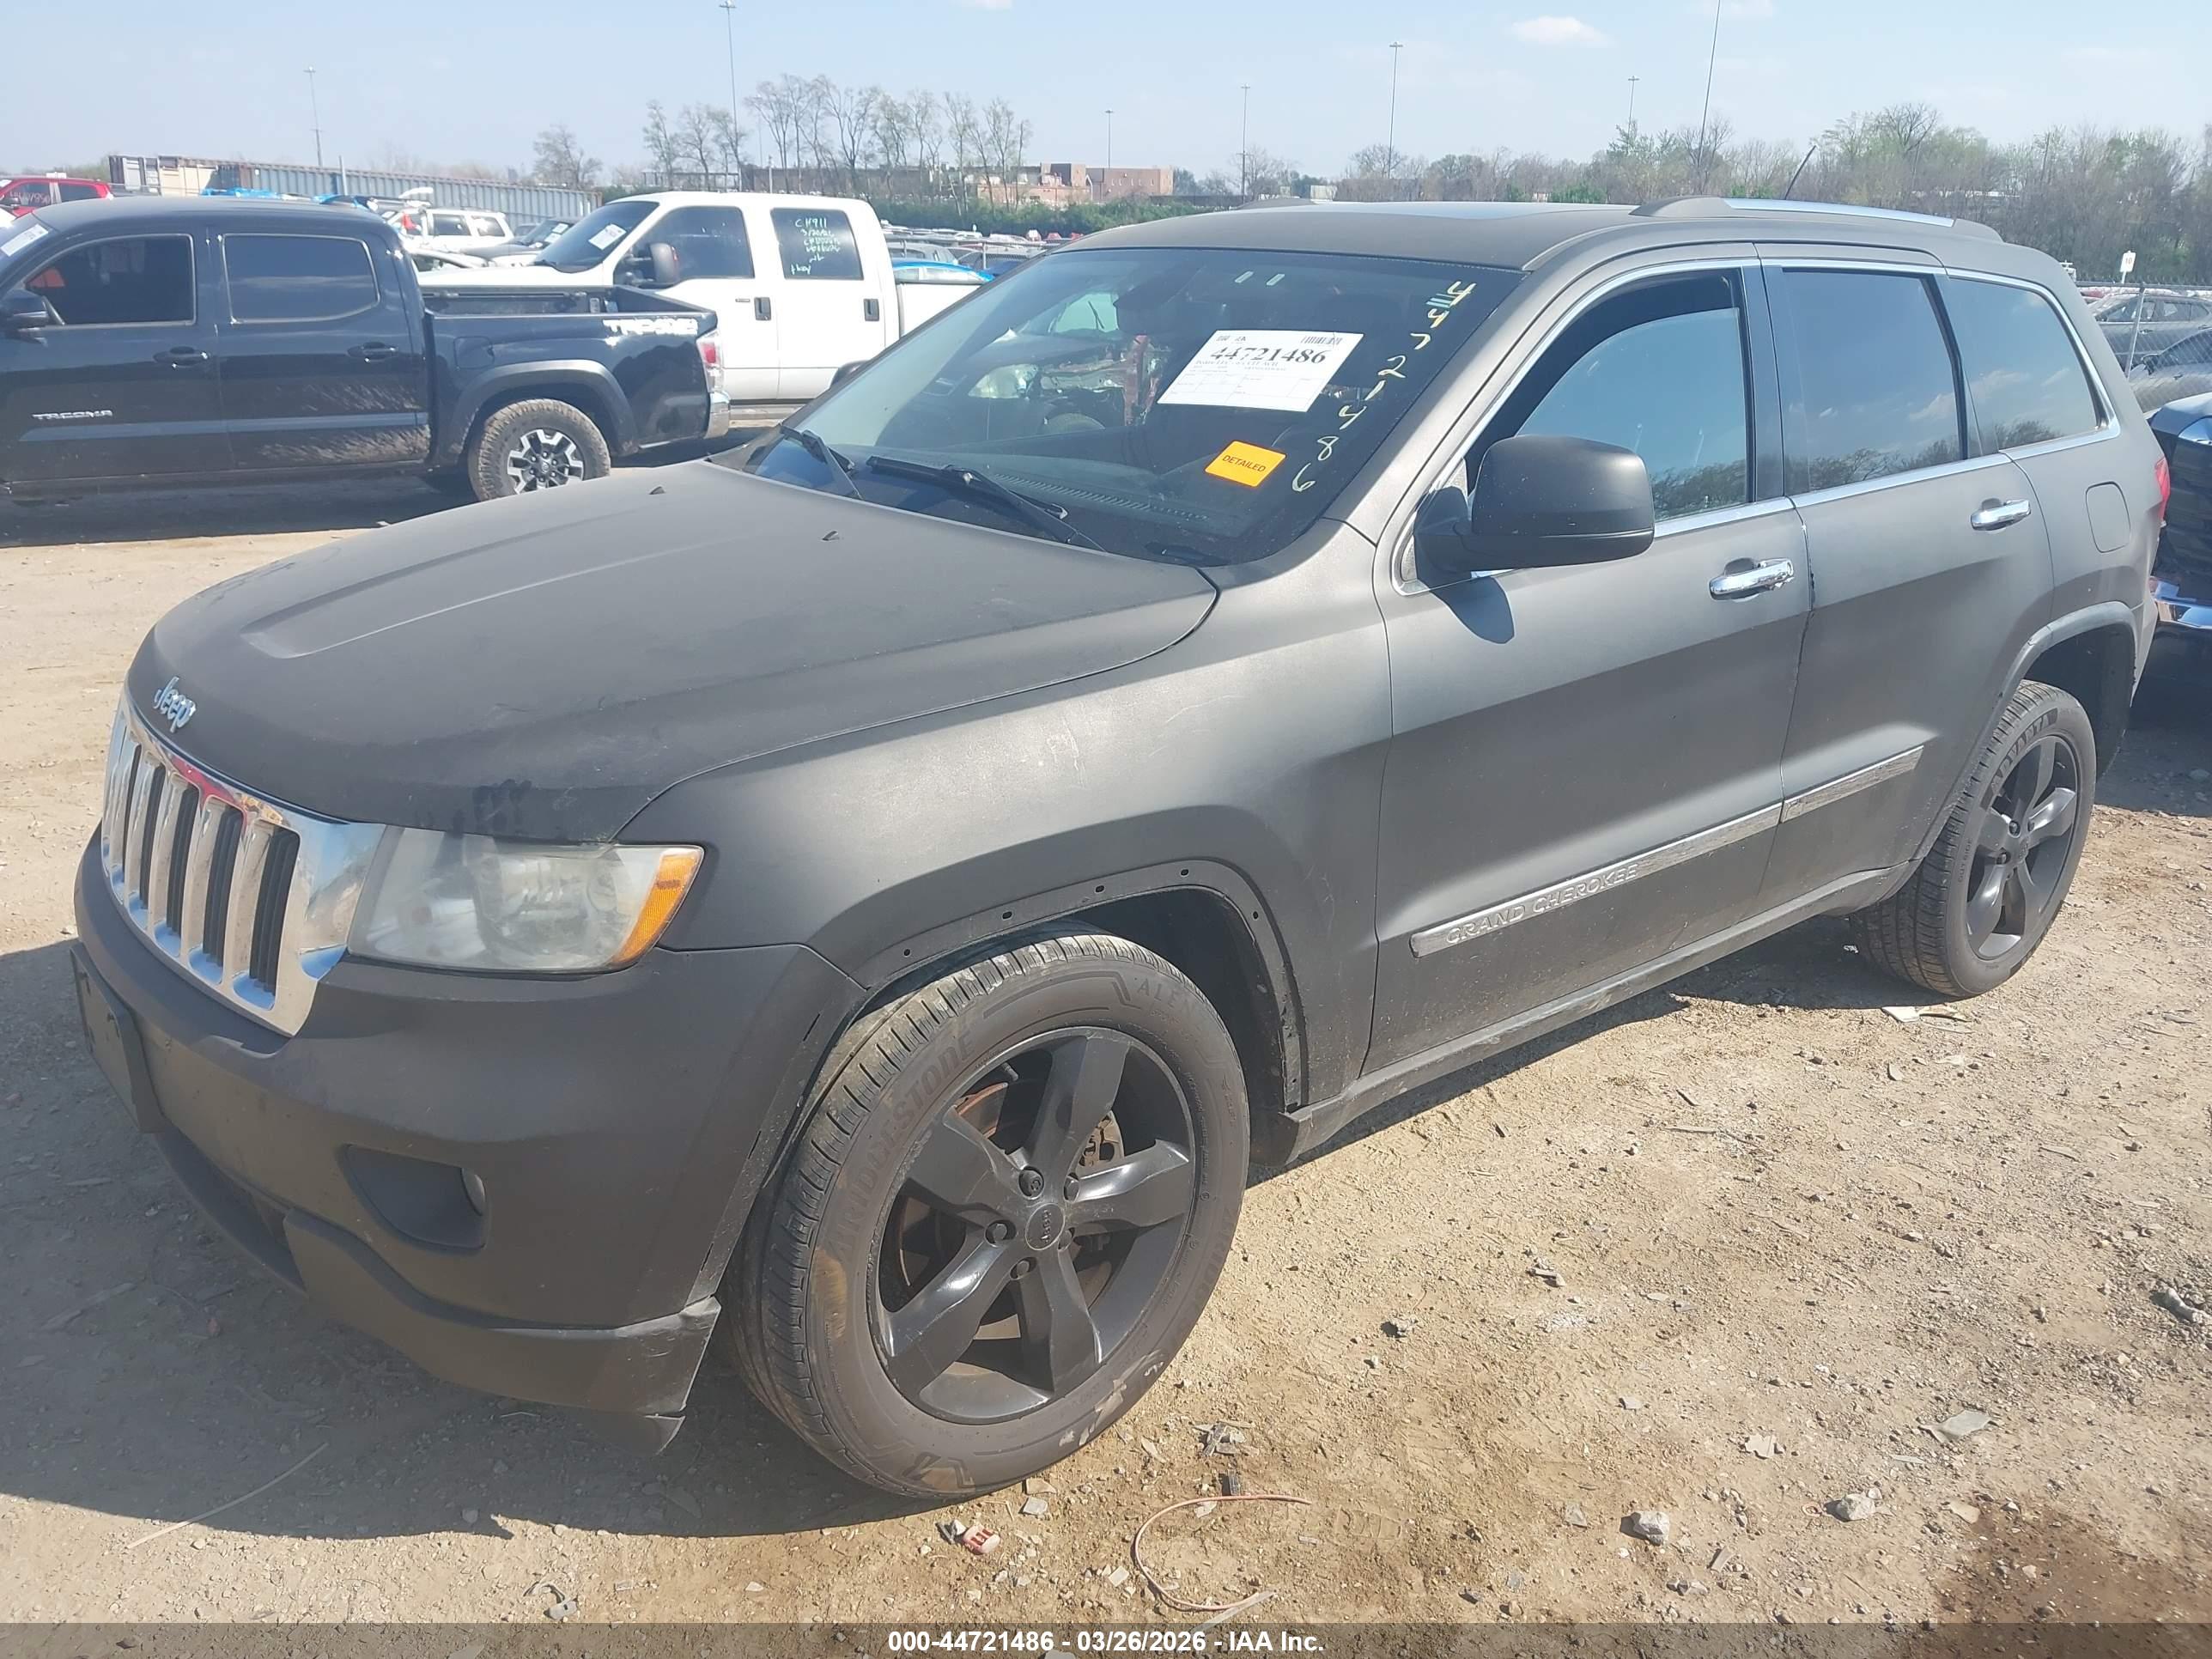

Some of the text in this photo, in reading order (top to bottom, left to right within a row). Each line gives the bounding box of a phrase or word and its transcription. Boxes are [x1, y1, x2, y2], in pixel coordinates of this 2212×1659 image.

[1210, 346, 1331, 365] 44721486
[1222, 454, 1267, 472] DETAILED
[153, 676, 197, 733] Jeep
[1446, 863, 1639, 945] GRAND CHEROKEE
